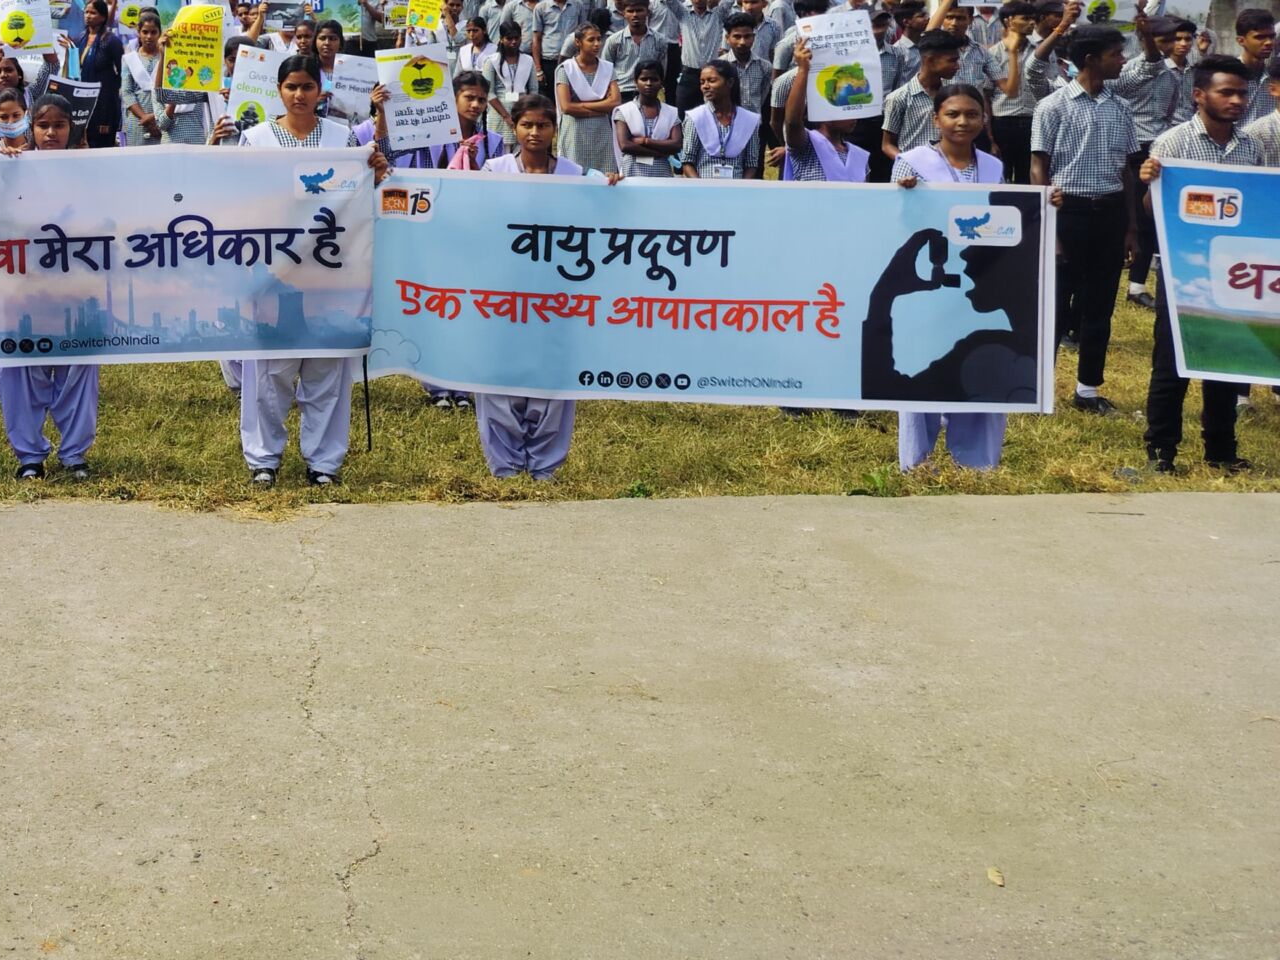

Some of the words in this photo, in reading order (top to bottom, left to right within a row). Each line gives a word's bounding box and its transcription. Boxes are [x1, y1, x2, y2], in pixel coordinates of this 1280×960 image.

[248, 70, 268, 81] Give
[335, 82, 346, 90] Be
[236, 82, 262, 96] clean
[265, 87, 278, 98] up
[410, 191, 430, 216] 15
[1217, 196, 1238, 220] 15
[34, 224, 116, 273] मेरा
[124, 214, 305, 268] अधिकार
[308, 206, 346, 268] है
[507, 224, 596, 282] वायु
[600, 226, 736, 292] प्रदूषण
[1228, 262, 1280, 300] ध
[395, 279, 466, 321] एक
[470, 290, 602, 326] स्वास्थ्य
[607, 296, 810, 332] आपातकाल
[813, 283, 846, 338] है
[59, 334, 160, 351] @SwitchONIndia
[697, 375, 802, 390] @SwitchONIndia
